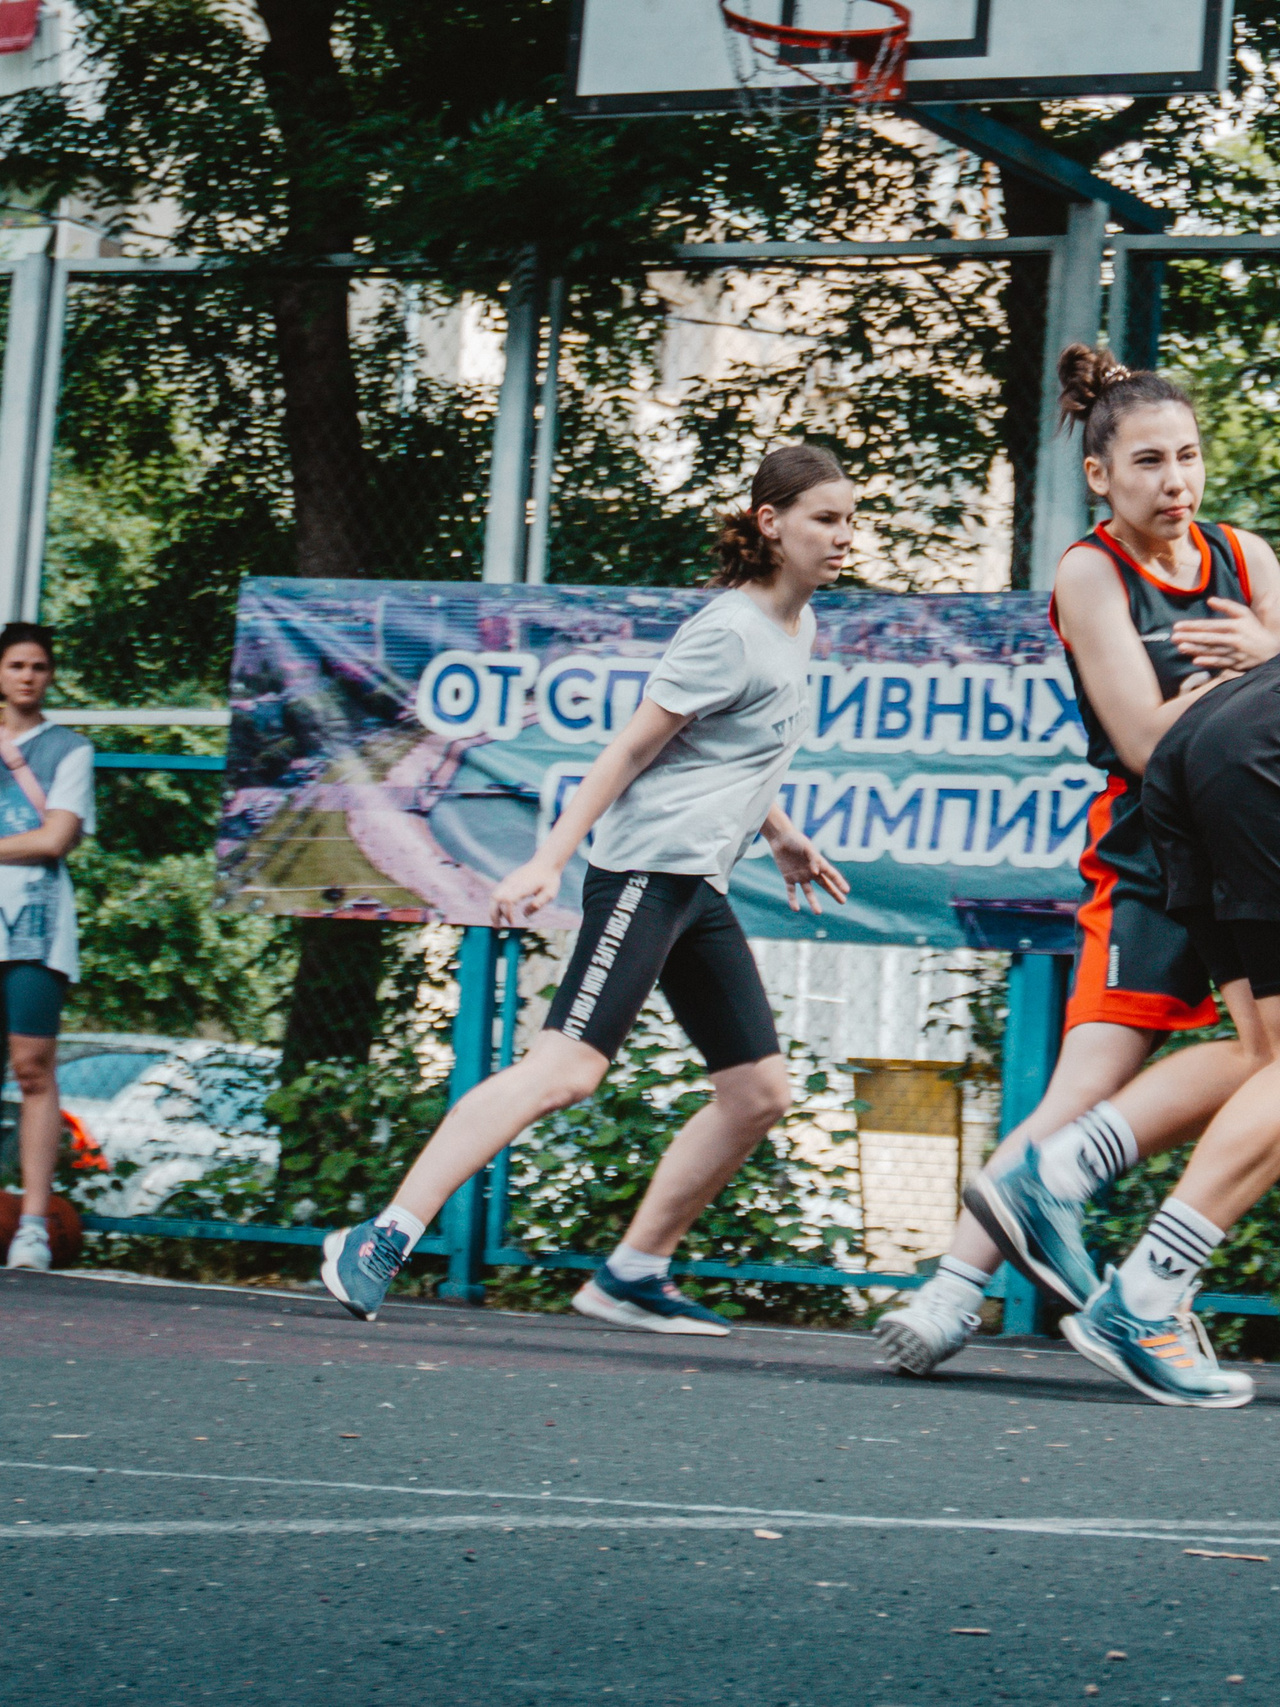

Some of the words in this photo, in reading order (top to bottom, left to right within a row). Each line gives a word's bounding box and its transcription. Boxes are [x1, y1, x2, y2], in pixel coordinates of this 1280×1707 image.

[432, 662, 523, 728] ОТ
[549, 667, 1088, 742] СПИВНЫХ
[604, 909, 631, 940] FOR
[591, 935, 621, 969] LIFE
[569, 992, 597, 1022] FOR
